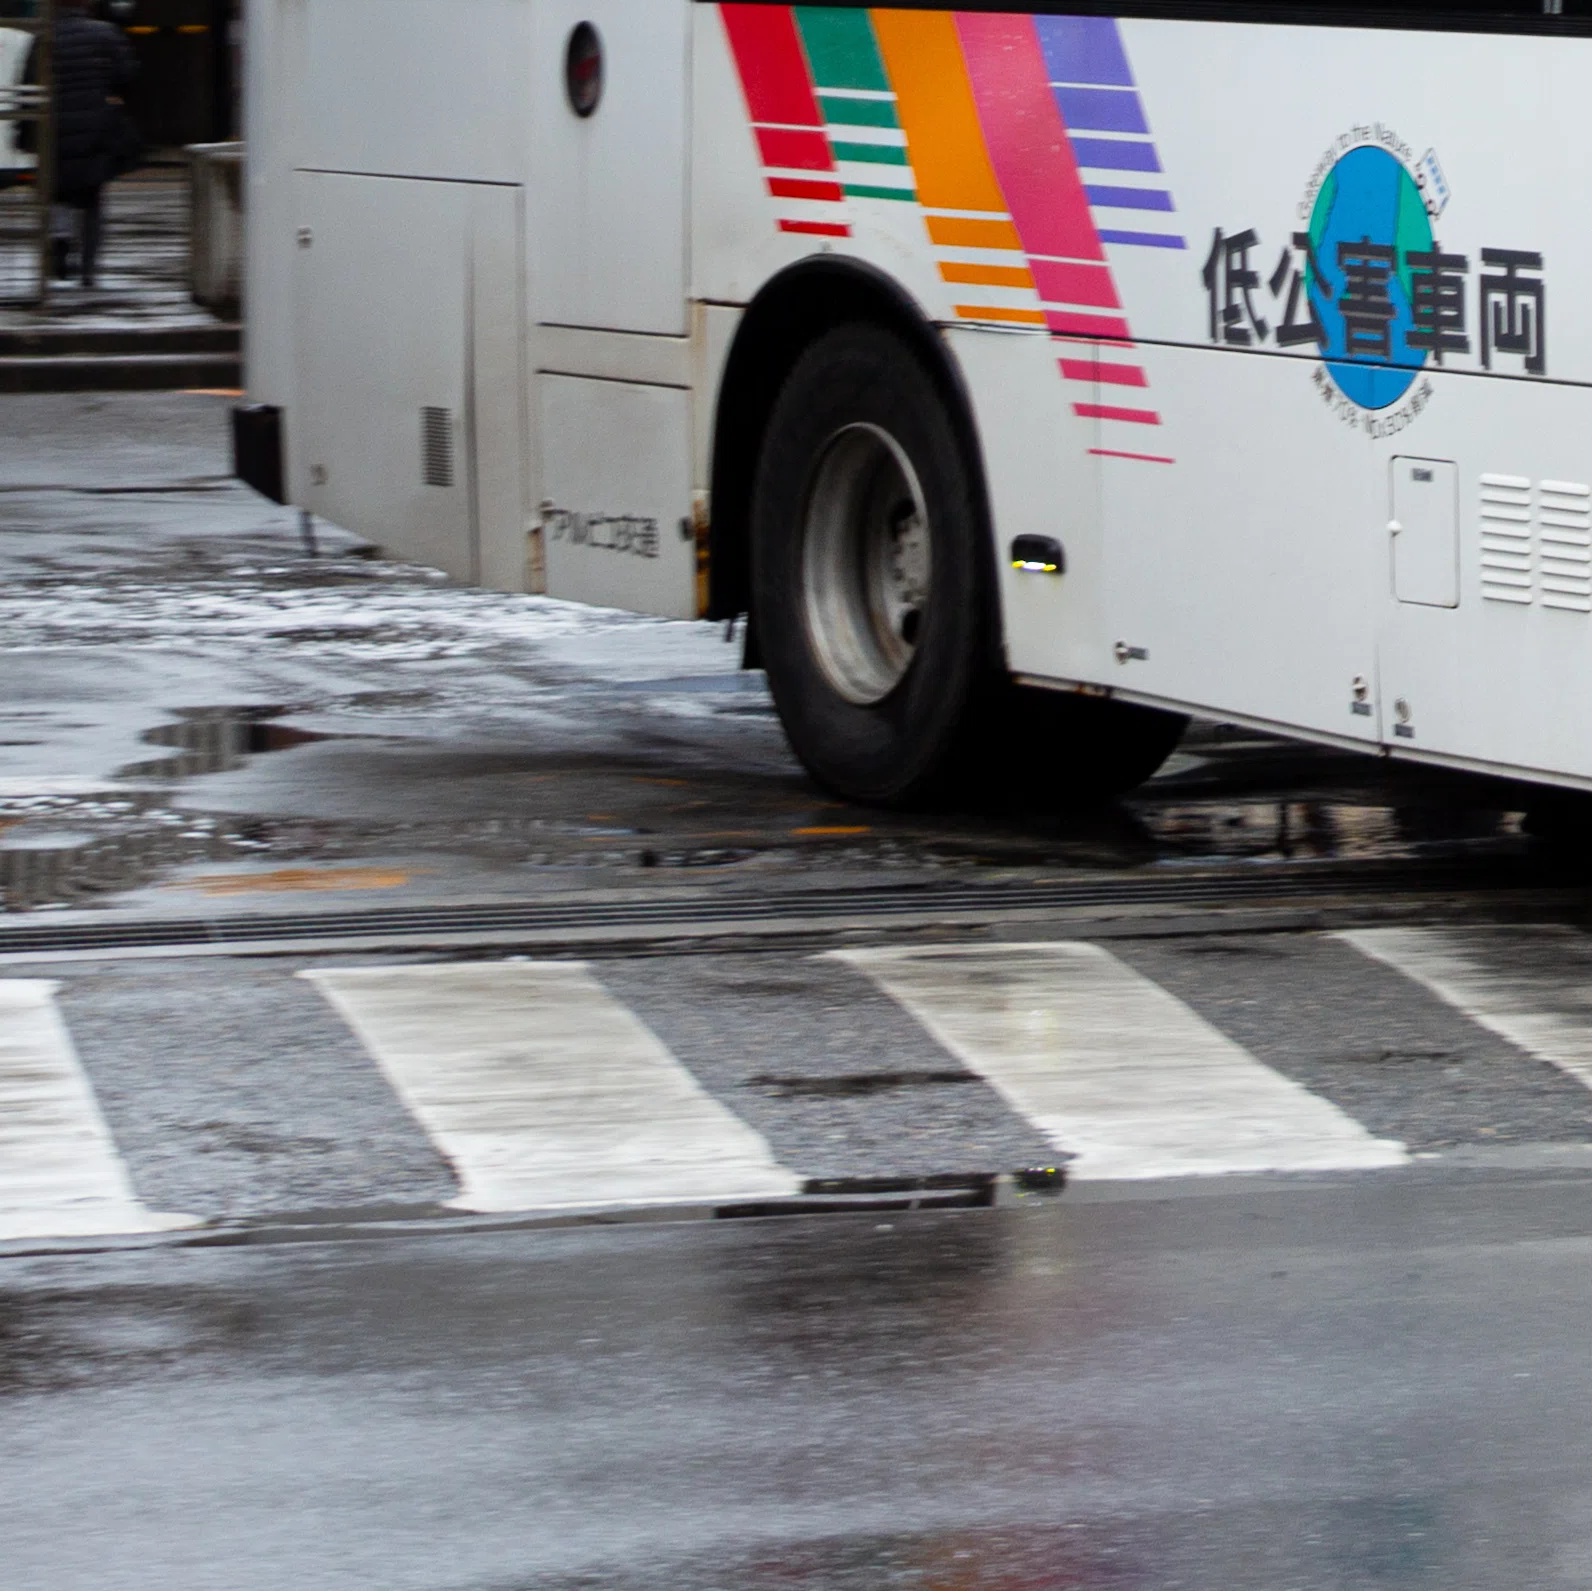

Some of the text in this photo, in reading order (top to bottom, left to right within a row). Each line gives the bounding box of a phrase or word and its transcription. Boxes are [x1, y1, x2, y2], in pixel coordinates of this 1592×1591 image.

[1201, 227, 1546, 376] 低公害車両
